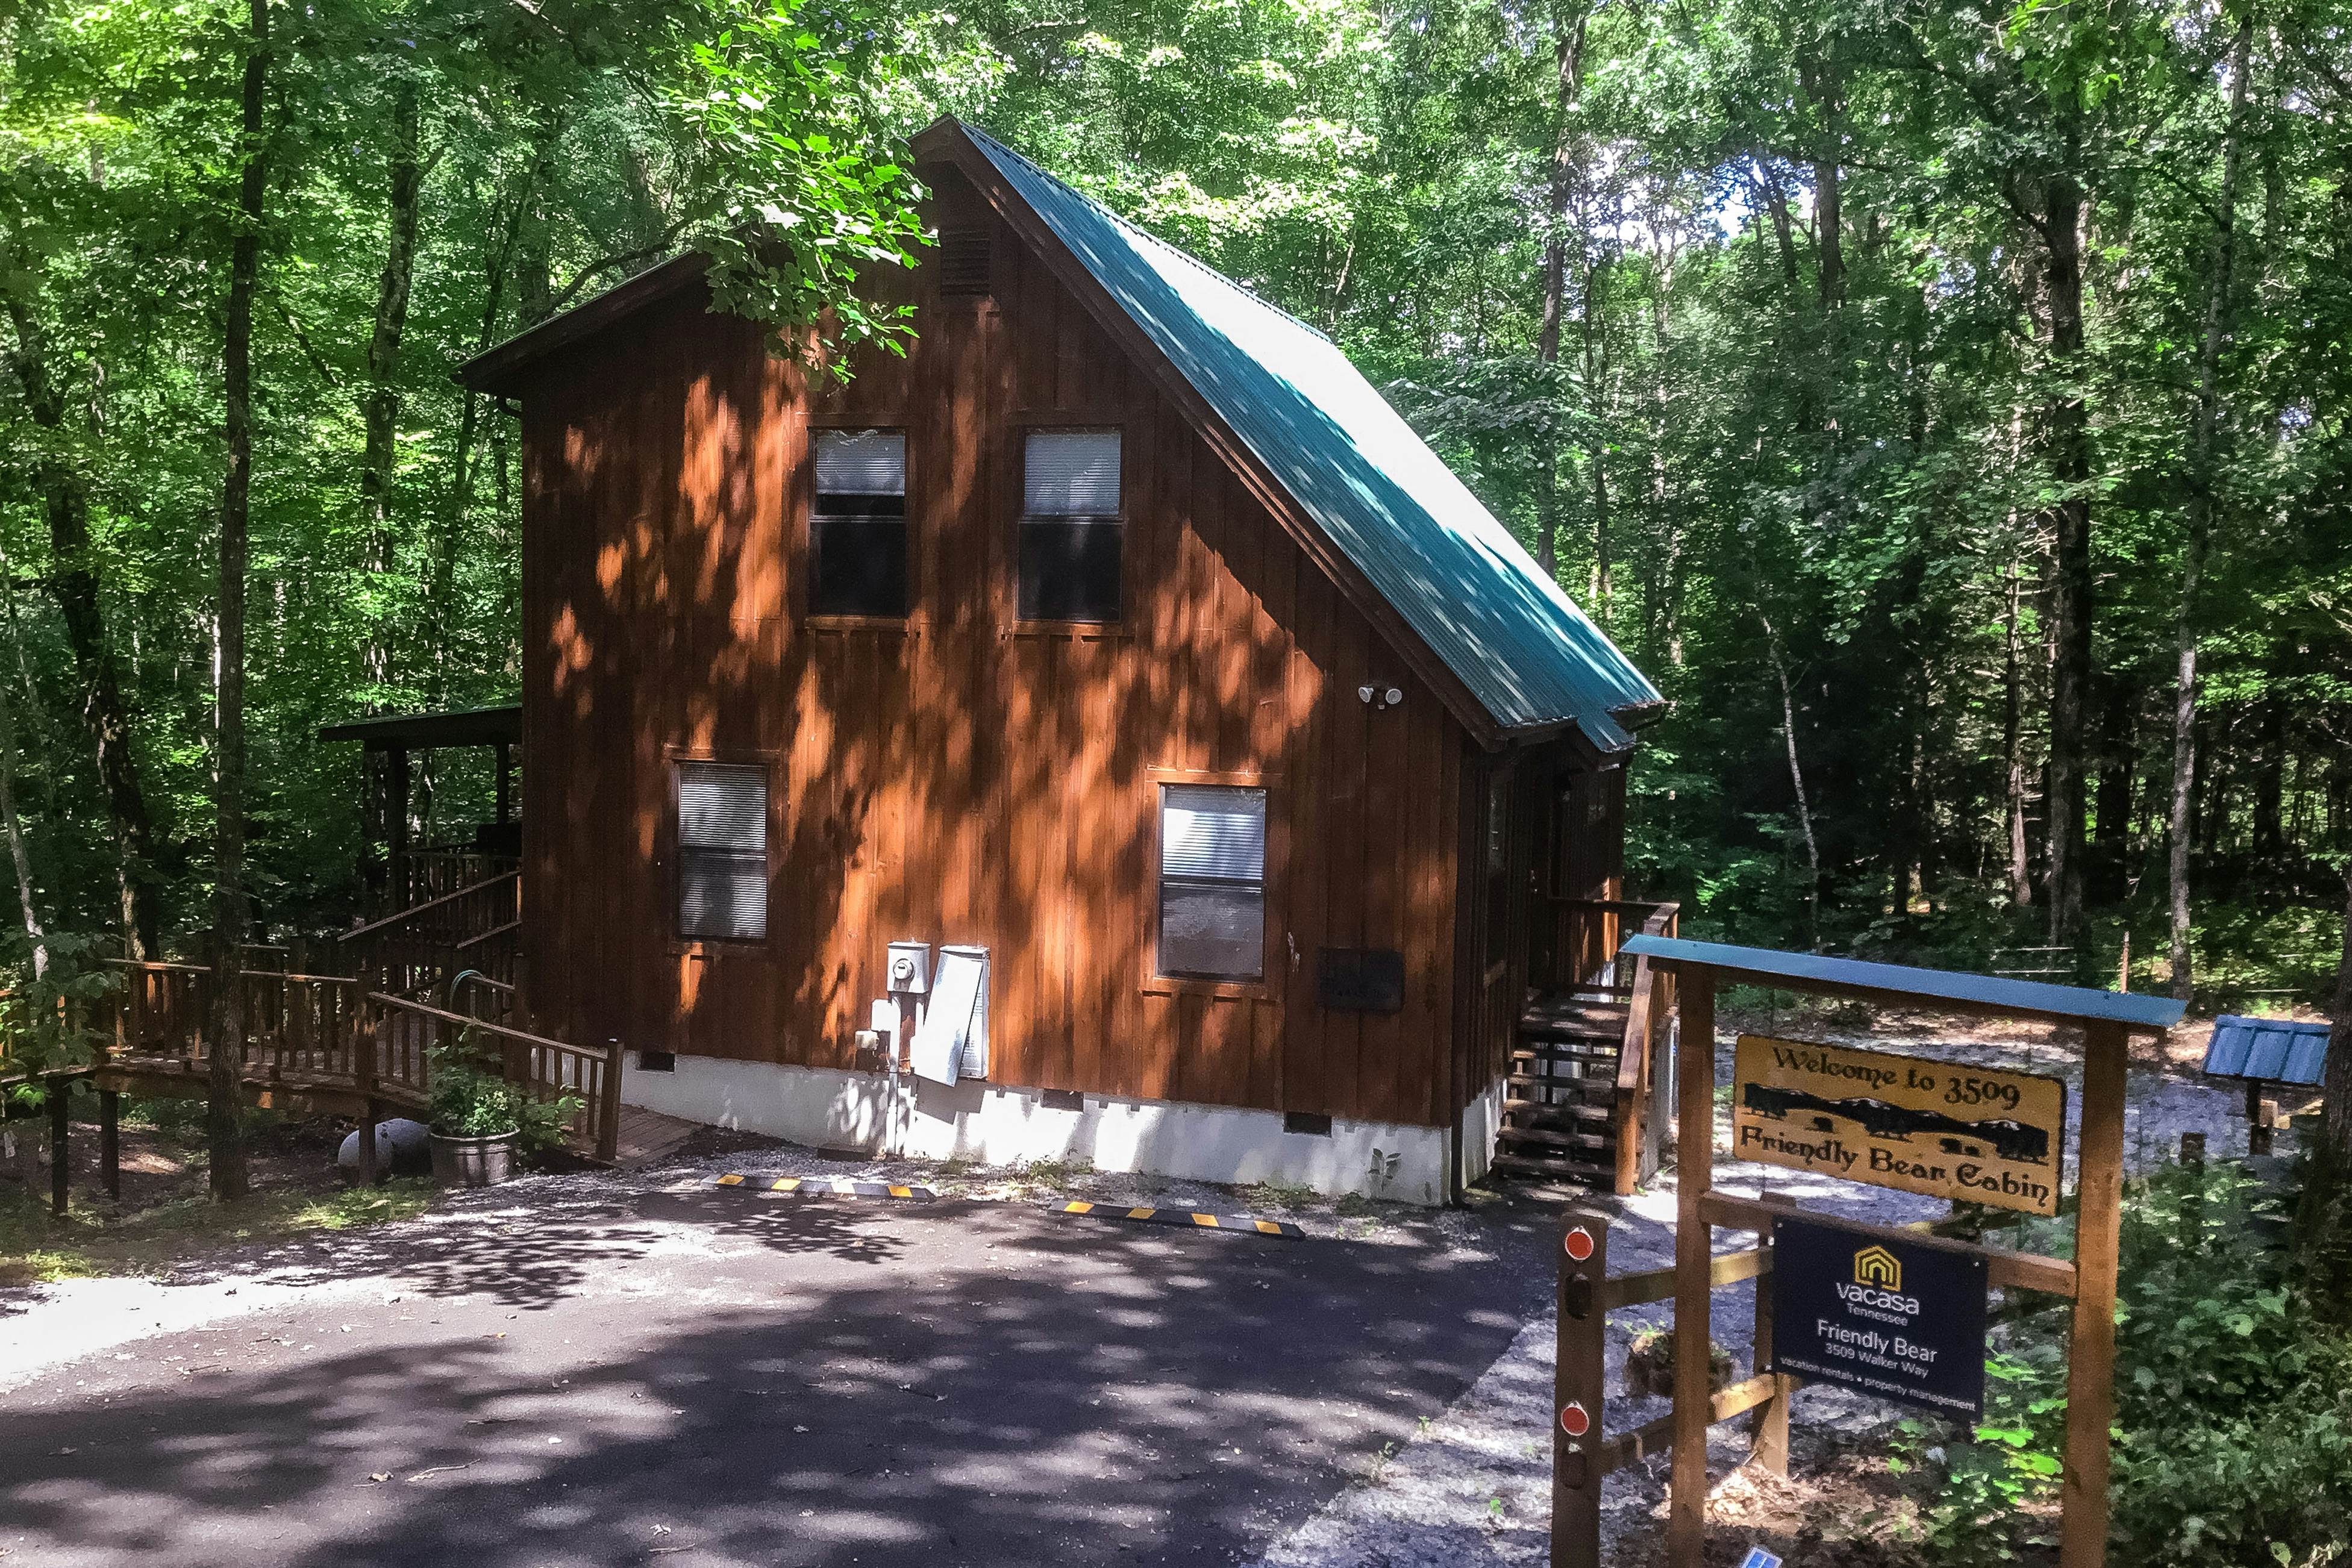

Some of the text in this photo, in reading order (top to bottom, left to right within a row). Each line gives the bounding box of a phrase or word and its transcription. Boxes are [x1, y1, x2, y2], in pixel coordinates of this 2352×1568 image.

[1773, 1046, 2021, 1110] Welcome to 3509
[1741, 1125, 2050, 1207] Friendly Bear Cabin
[1836, 1282, 1920, 1315] vacasa
[1847, 1303, 1908, 1326] Tennessee
[1817, 1319, 1938, 1363] Friendly Bear
[1825, 1343, 1929, 1379] 3509 Walker Way
[1780, 1357, 1976, 1412] vacation rentals property management
